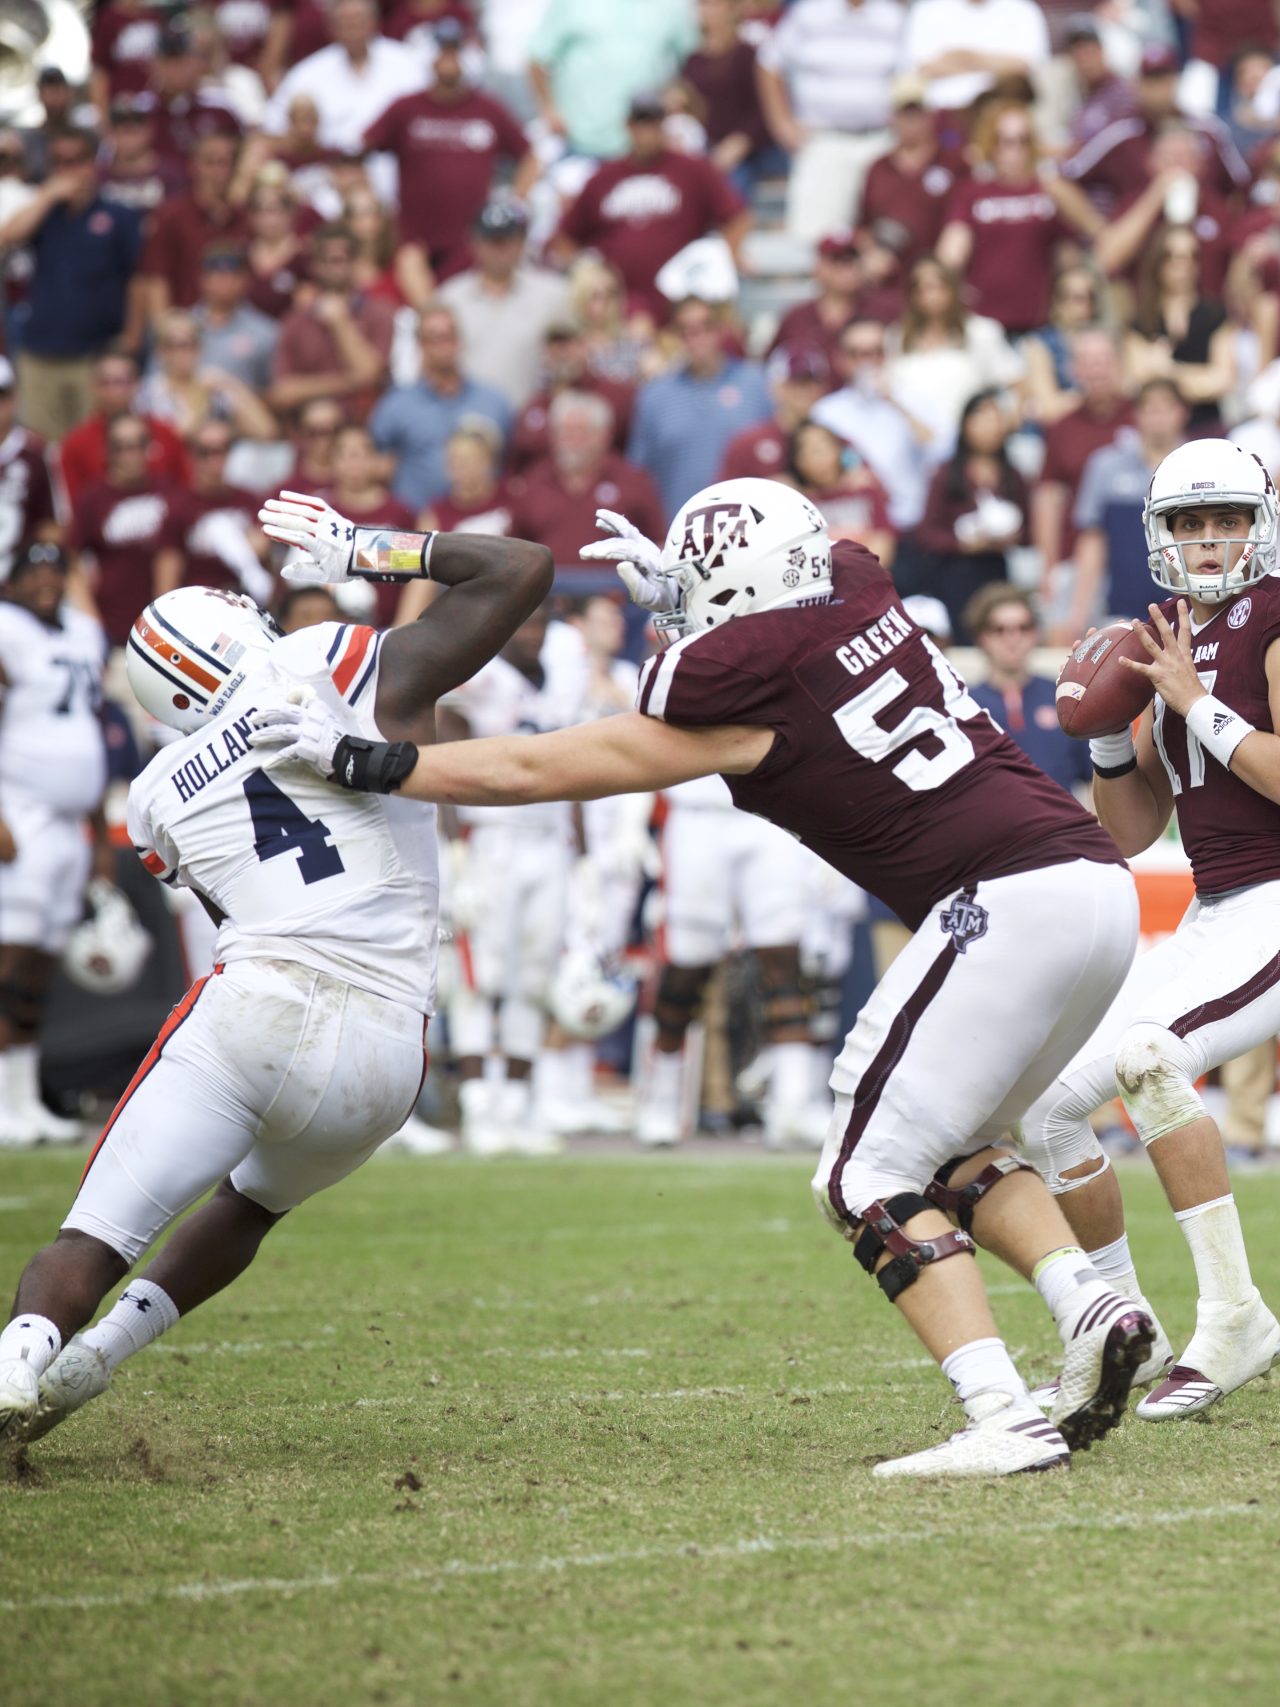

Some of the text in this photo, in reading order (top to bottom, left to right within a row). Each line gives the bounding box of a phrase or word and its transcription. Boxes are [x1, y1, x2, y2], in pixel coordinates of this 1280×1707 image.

[836, 606, 912, 676] GREEN
[209, 697, 227, 716] WAR
[222, 671, 246, 699] EAGLE
[832, 634, 1005, 791] 54
[1214, 716, 1235, 735] adidas
[243, 767, 346, 885] 4
